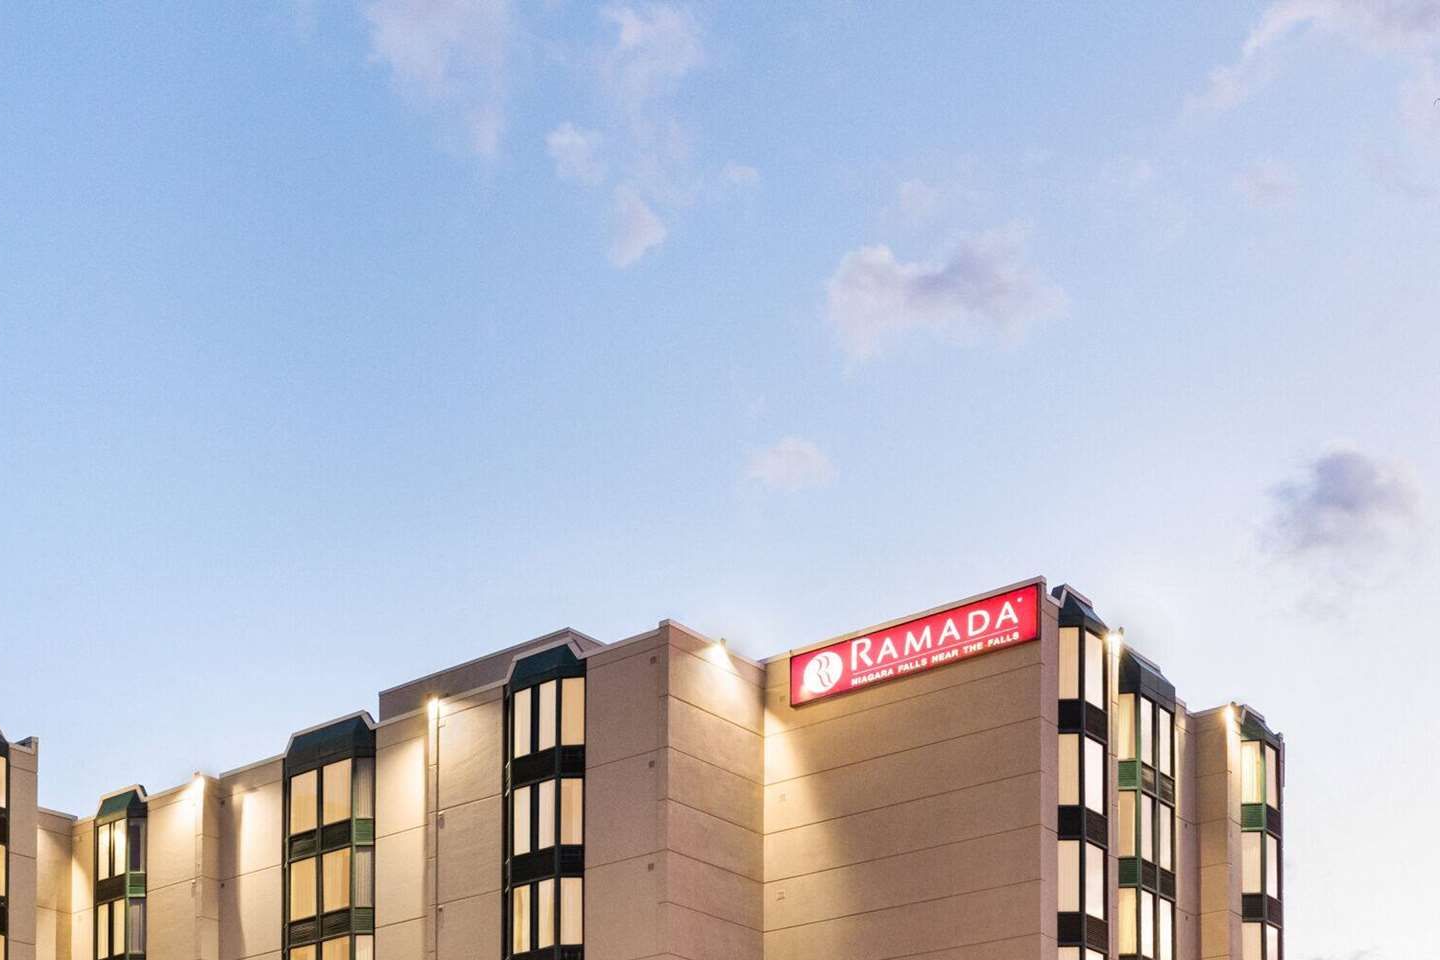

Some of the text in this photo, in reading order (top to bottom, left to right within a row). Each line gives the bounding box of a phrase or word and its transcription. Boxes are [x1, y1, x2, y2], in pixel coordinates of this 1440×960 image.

[851, 601, 1019, 671] RAMADA
[851, 632, 1019, 687] NIAGARA FALLS NEAR THE FALLS
